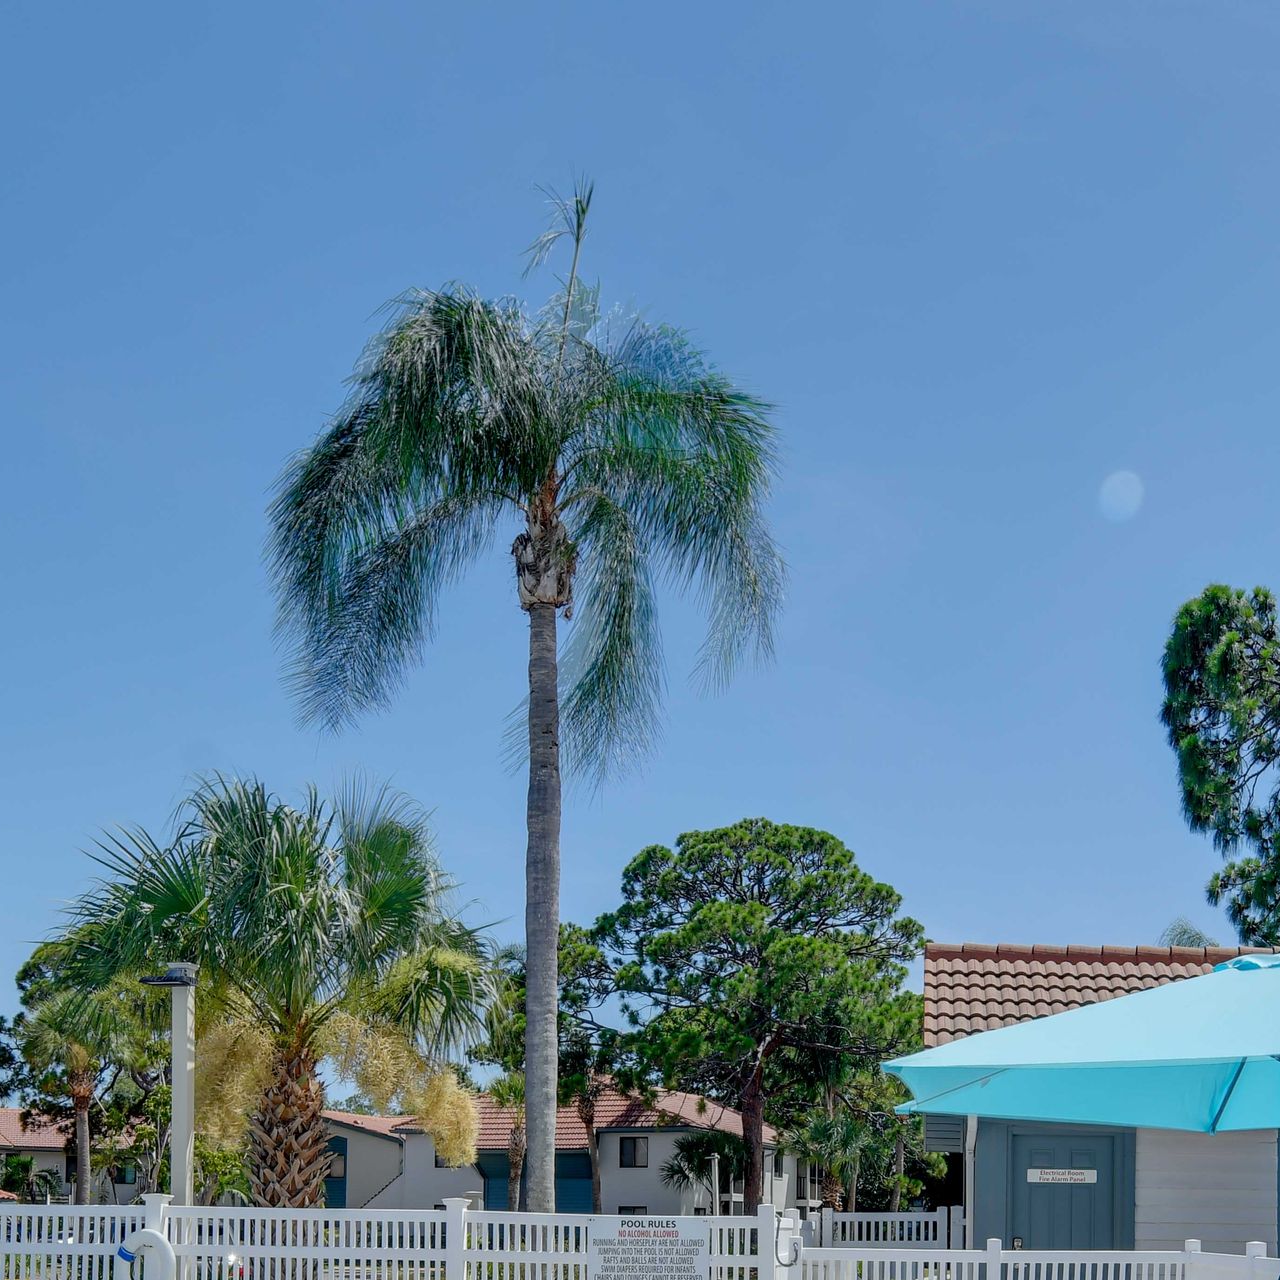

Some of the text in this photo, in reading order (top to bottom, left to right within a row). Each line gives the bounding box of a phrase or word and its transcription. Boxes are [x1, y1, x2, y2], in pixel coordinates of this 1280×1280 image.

[621, 1220, 645, 1228] POOL
[653, 1230, 679, 1238] ALLOWED
[593, 1238, 616, 1246] RUNNING
[659, 1239, 667, 1247] ARE
[669, 1239, 679, 1247] NOT
[598, 1247, 620, 1255] JUMPING
[675, 1248, 699, 1256] ALLOWED
[670, 1257, 693, 1265] ALLOWED
[601, 1265, 615, 1273] SWIM
[617, 1265, 637, 1273] DIAPERS
[639, 1265, 663, 1273] REQUIRED
